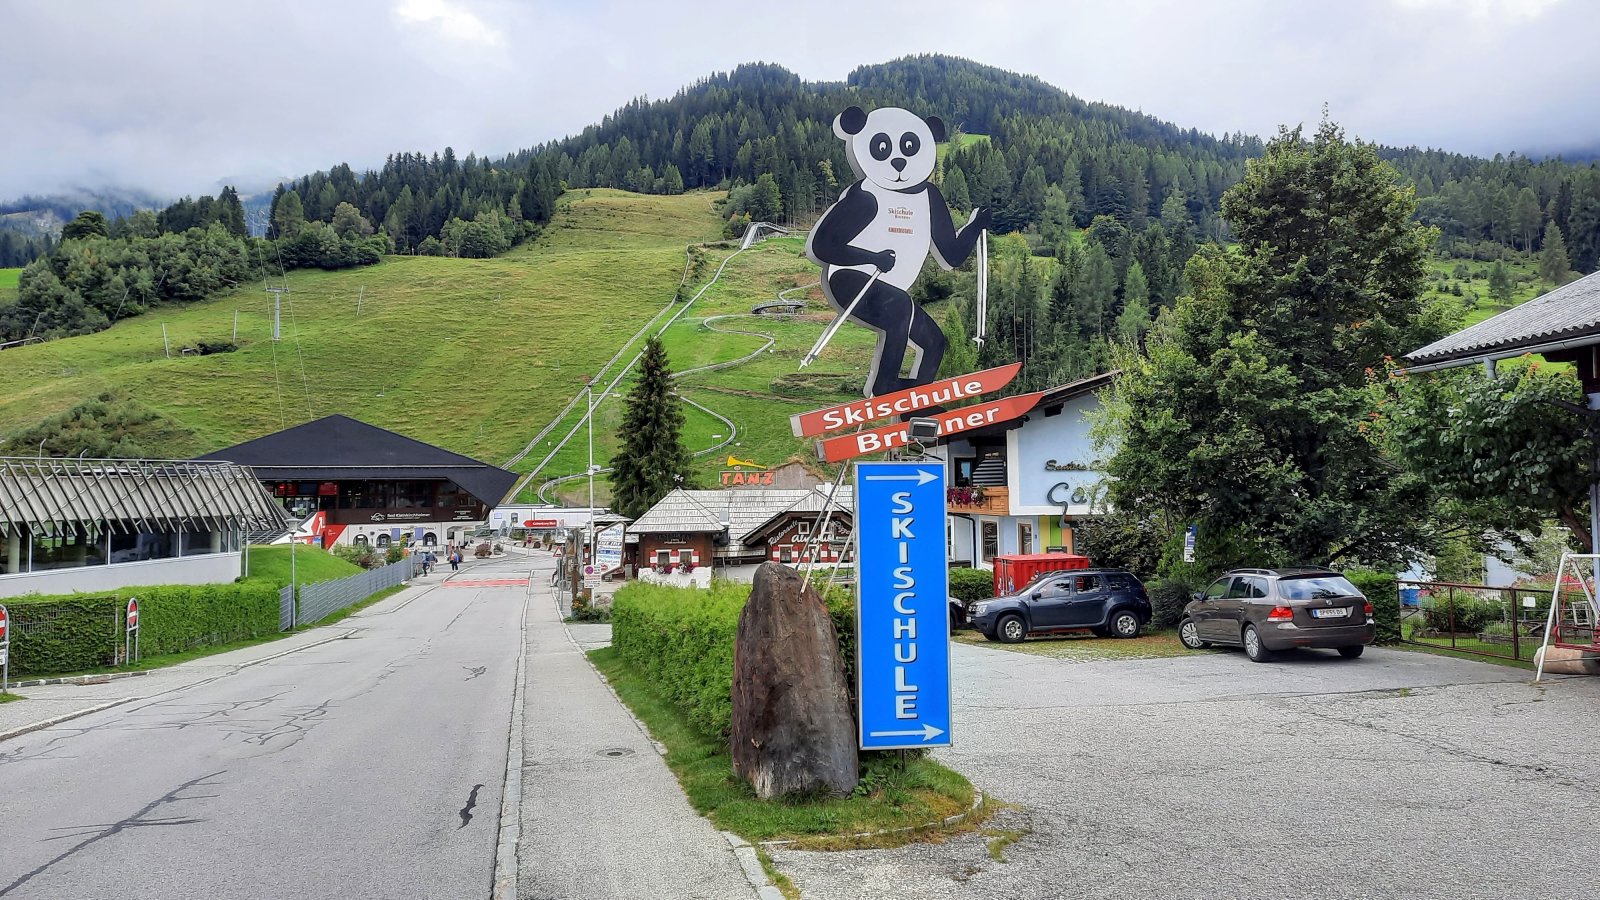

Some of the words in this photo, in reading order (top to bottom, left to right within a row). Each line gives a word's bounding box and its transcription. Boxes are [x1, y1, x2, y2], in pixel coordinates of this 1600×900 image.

[822, 380, 983, 430] Skischule
[856, 407, 1000, 454] Brner
[722, 472, 774, 485] TANZ
[767, 520, 798, 547] Ristorante
[891, 491, 918, 720] SKISCHULE
